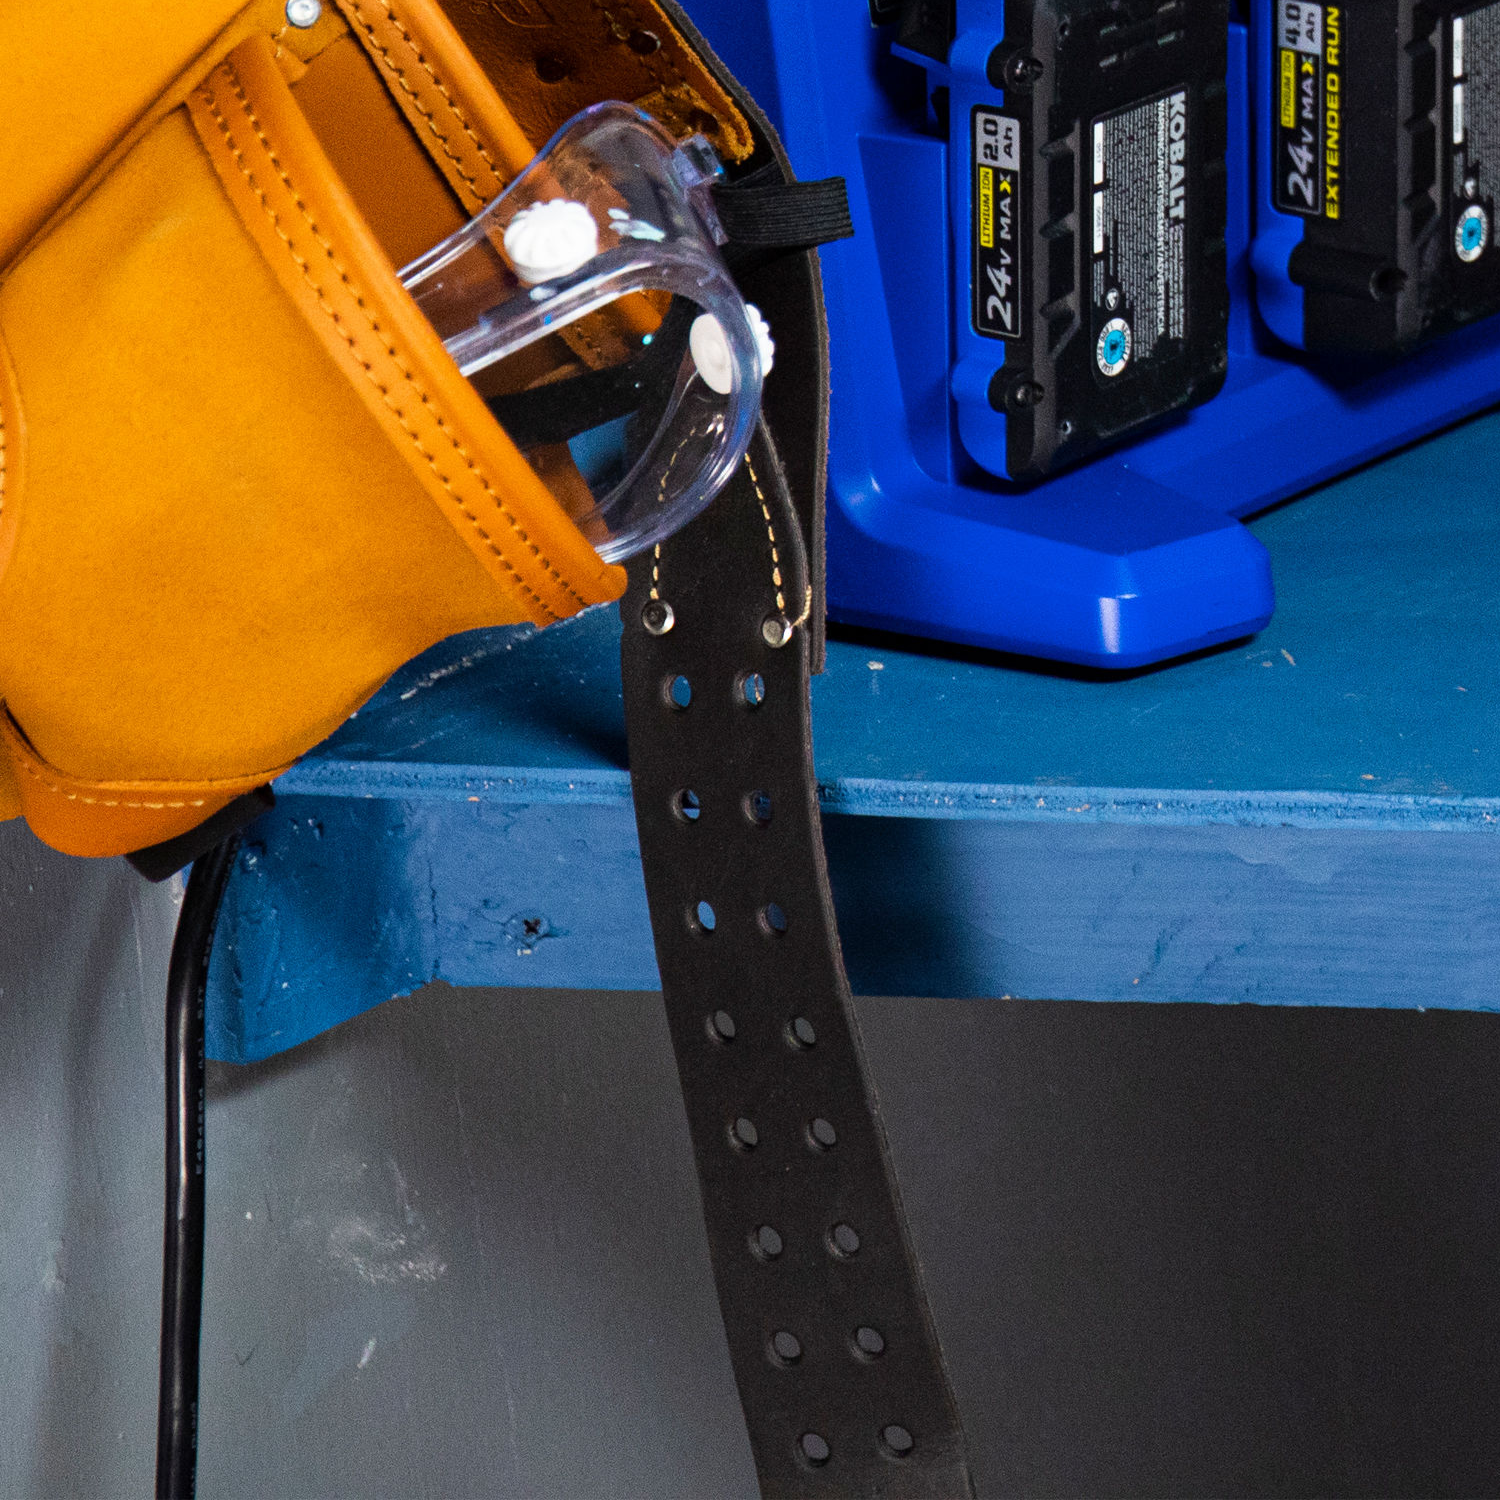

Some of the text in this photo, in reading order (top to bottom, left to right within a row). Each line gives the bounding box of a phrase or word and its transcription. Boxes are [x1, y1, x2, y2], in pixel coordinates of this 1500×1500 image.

[1285, 3, 1301, 46] 4.0
[1302, 55, 1314, 120] MAX
[1326, 6, 1340, 219] EXTENDED RUN
[983, 118, 999, 162] 2.0
[1003, 127, 1013, 159] Ah
[1169, 91, 1186, 219] KOBALT
[981, 169, 992, 245] LITHIUM ION
[999, 173, 1012, 240] MAX
